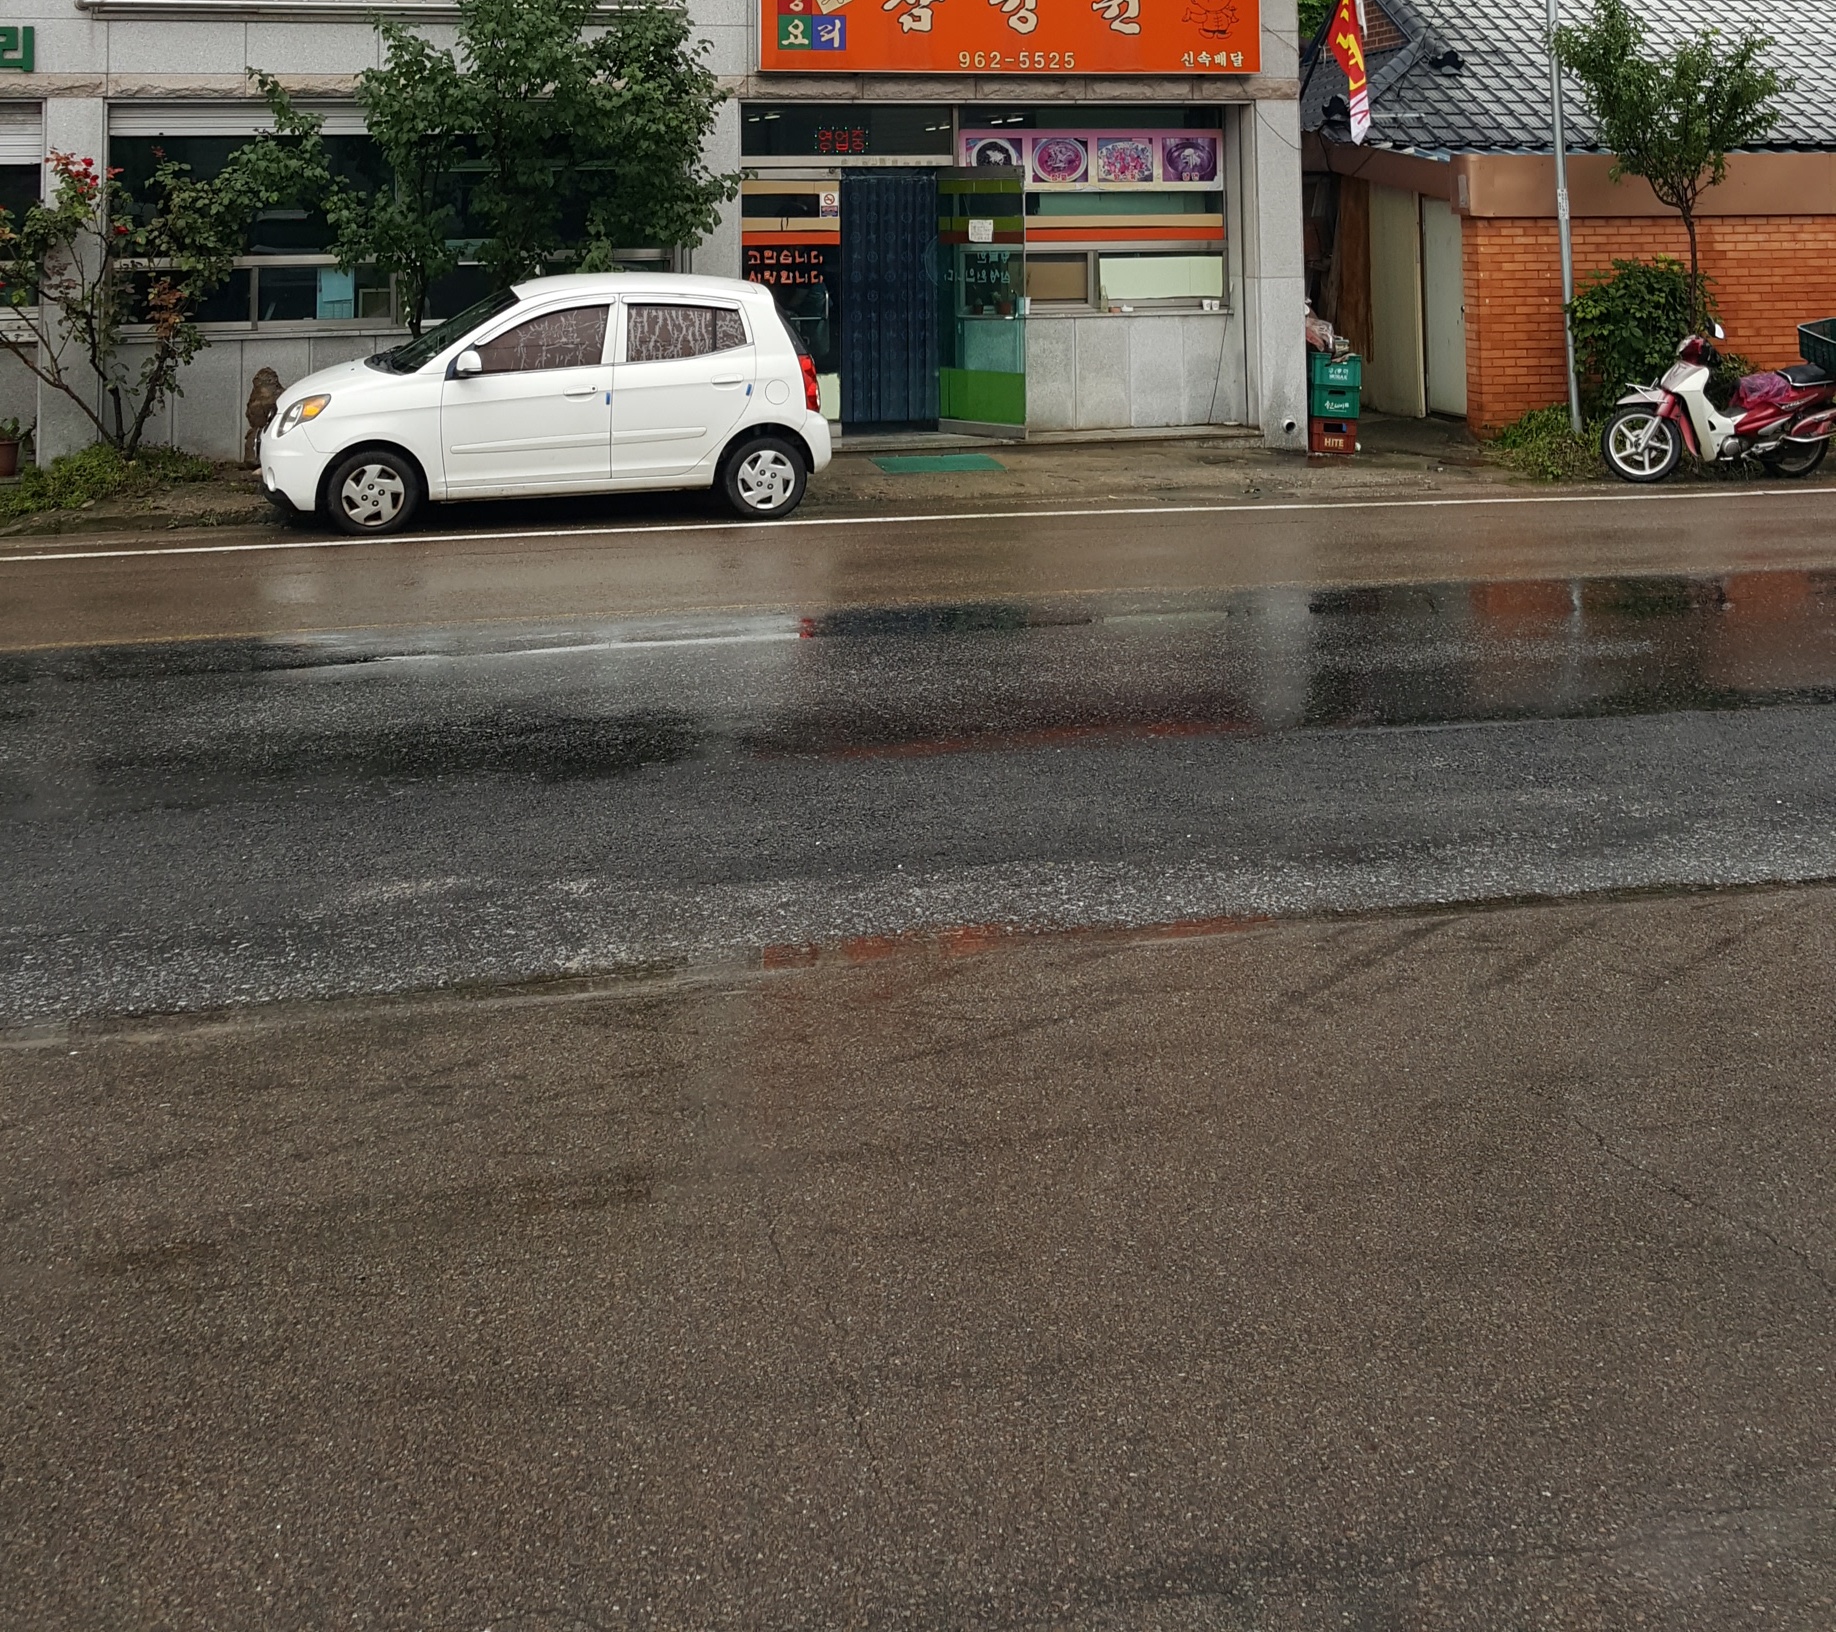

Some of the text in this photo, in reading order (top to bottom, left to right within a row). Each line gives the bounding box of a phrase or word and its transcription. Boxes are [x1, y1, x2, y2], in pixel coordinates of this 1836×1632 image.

[957, 50, 1076, 69] 962-5525
[1180, 50, 1245, 68] 신속배달
[818, 129, 865, 151] 영업중
[748, 250, 823, 265] 고맙습니다
[748, 270, 824, 284] 사랑합니다
[1324, 437, 1345, 448] HITE
